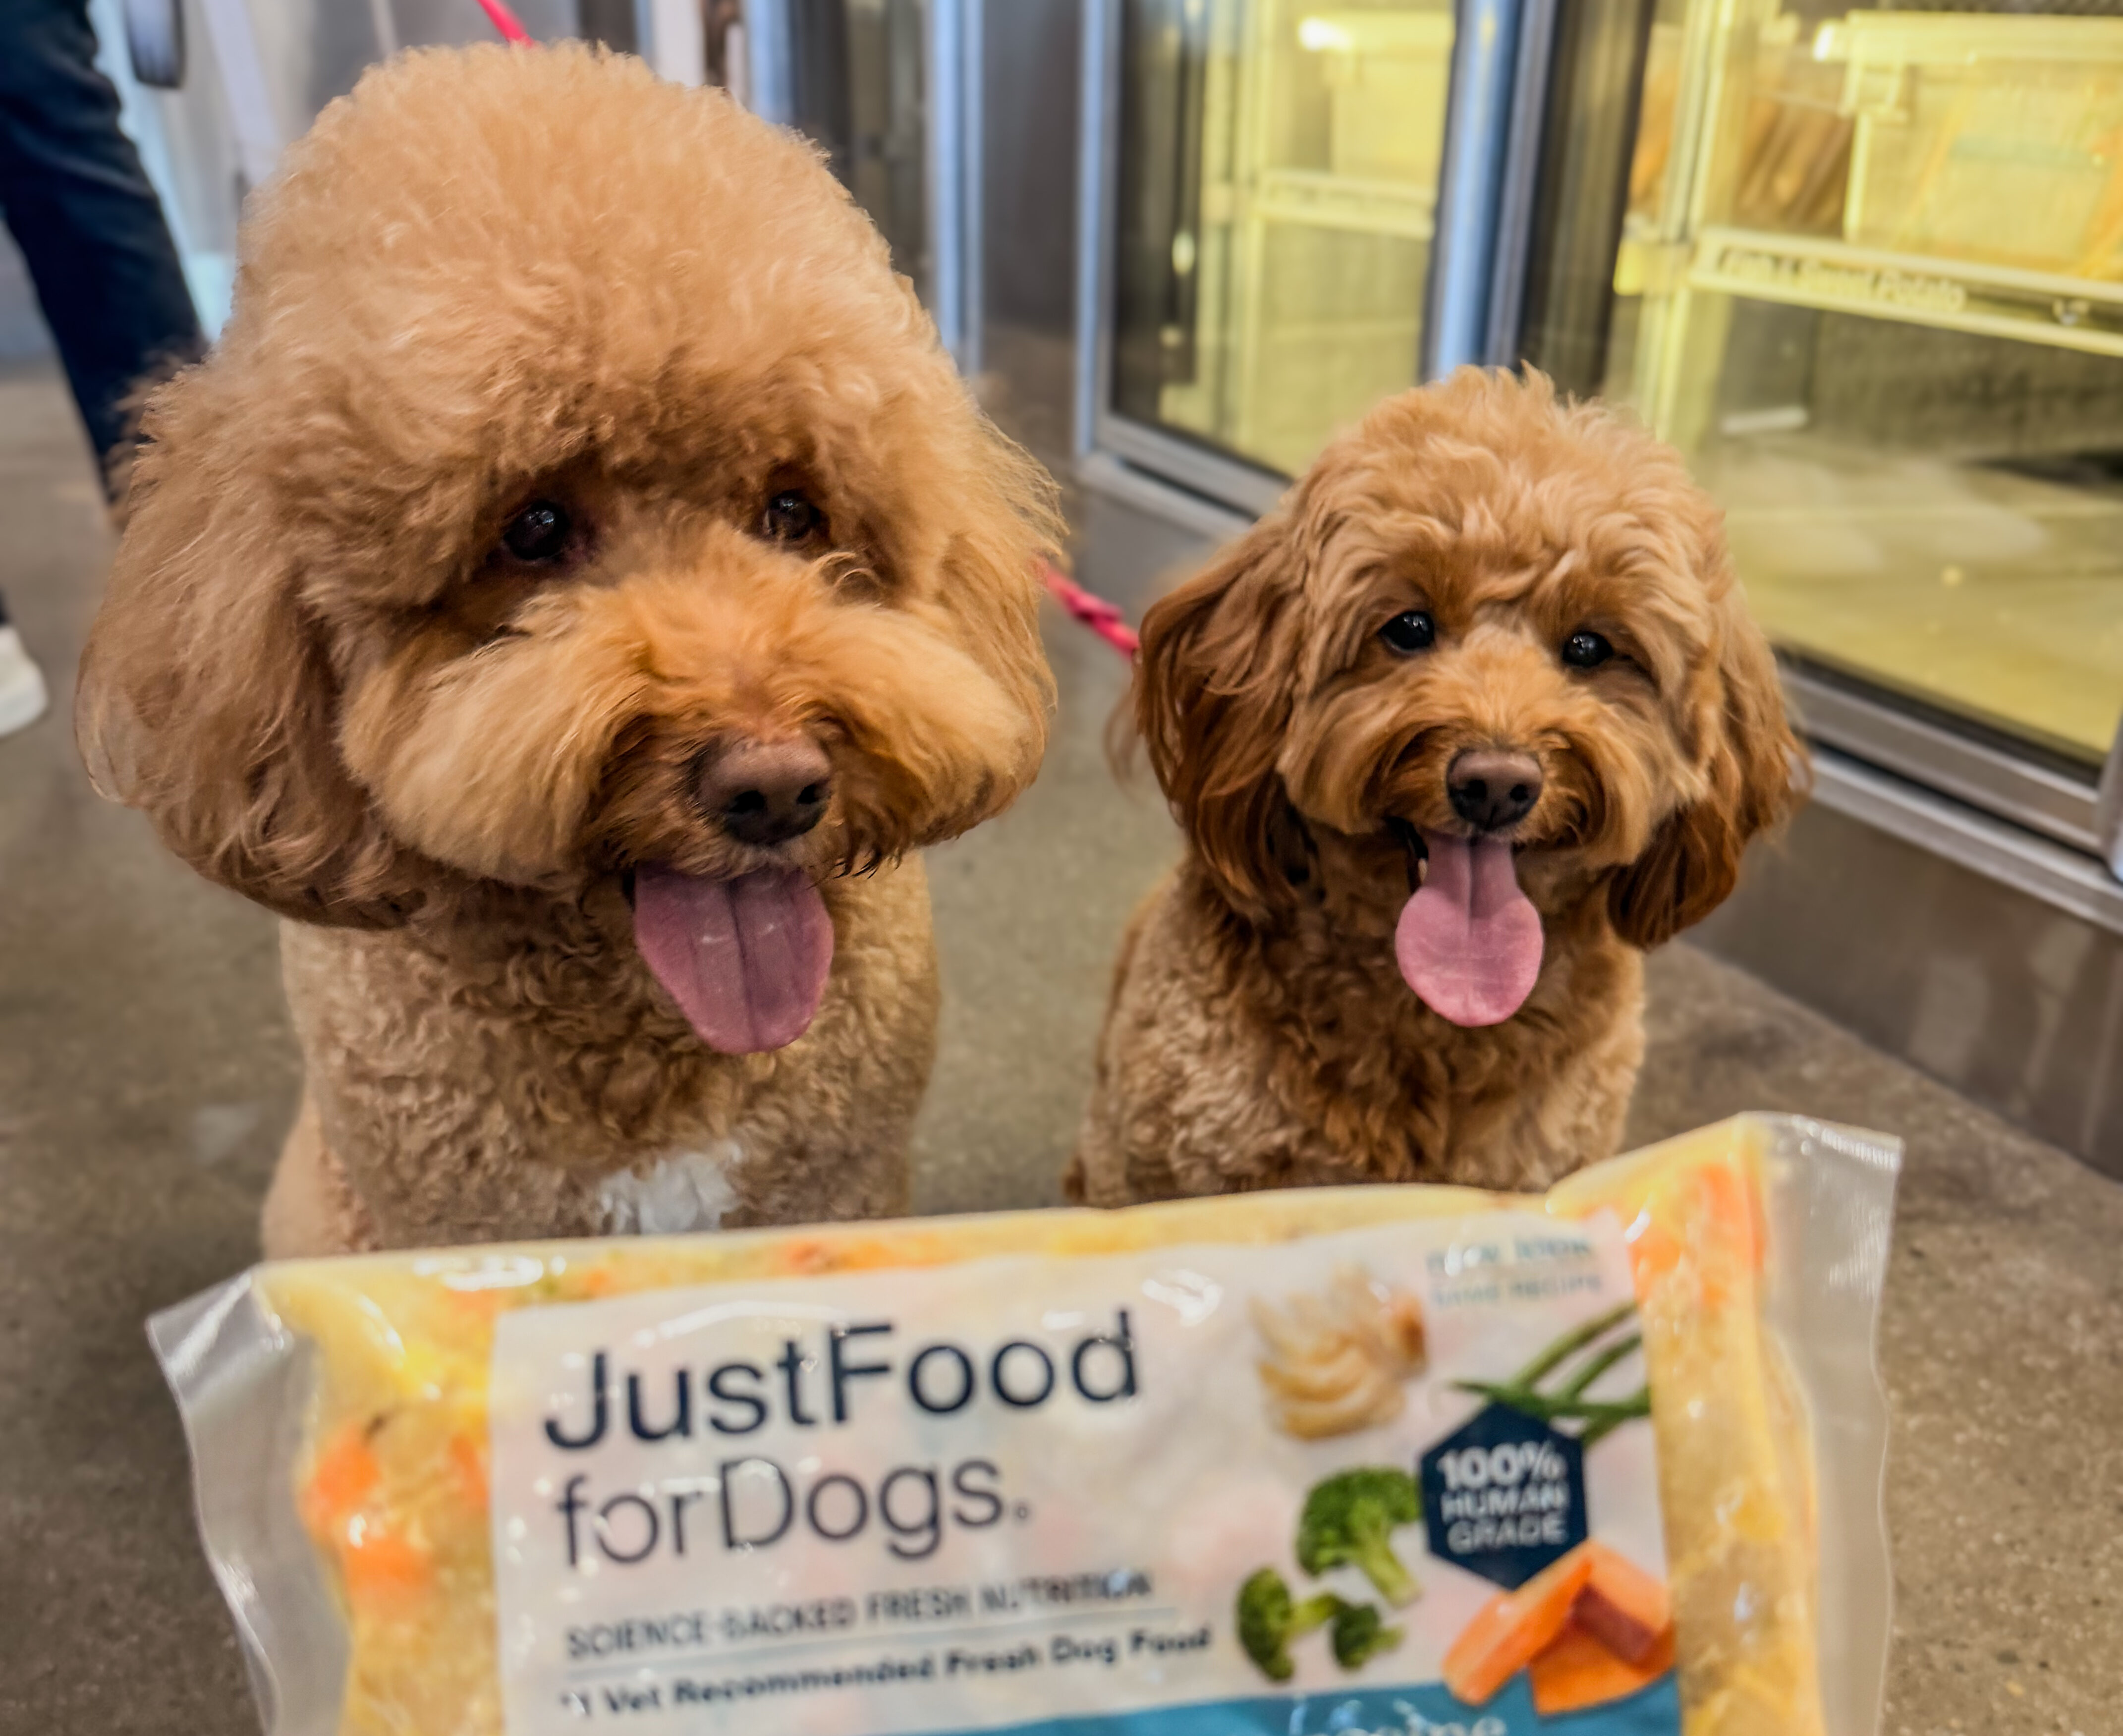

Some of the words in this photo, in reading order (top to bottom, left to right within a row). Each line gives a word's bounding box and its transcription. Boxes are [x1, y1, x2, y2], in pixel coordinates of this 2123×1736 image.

[1879, 268, 1967, 311] Potato
[544, 1306, 1141, 1451] JustFood
[1436, 1438, 1568, 1490] 100%
[1440, 1482, 1569, 1523] HUMAN
[1446, 1513, 1566, 1555] GRADE
[866, 1589, 970, 1622] FRESH
[978, 1569, 1152, 1610] NTRITION
[603, 1685, 662, 1715] Vet
[672, 1655, 934, 1705] Recommended
[945, 1644, 1039, 1673] Fresh
[1050, 1635, 1117, 1667] Dog
[1130, 1624, 1211, 1653] Food
